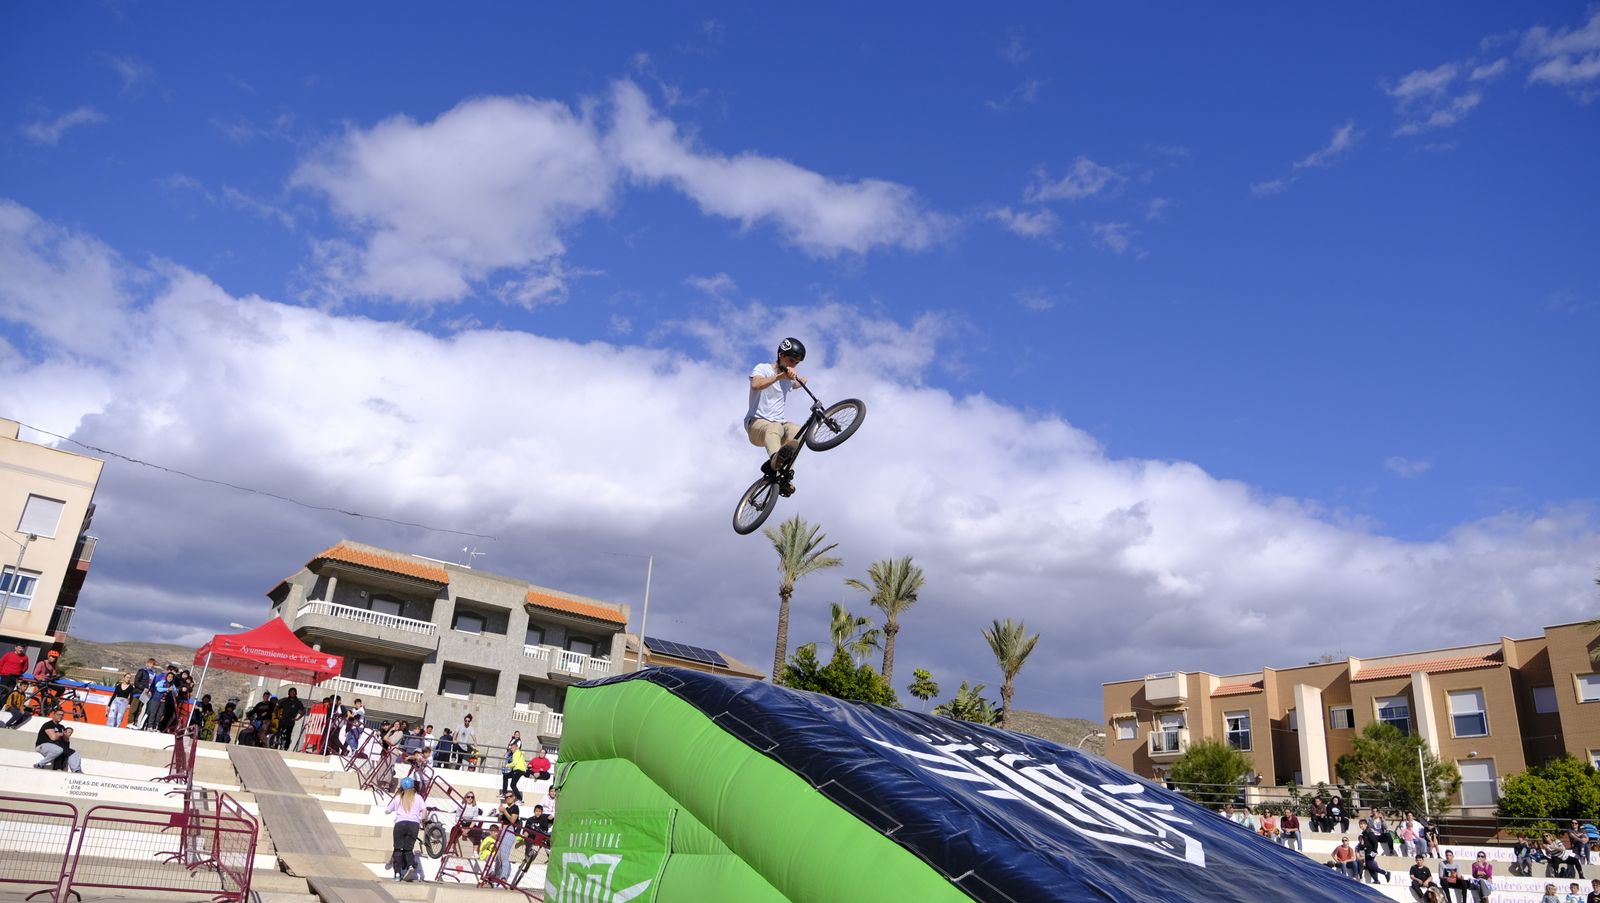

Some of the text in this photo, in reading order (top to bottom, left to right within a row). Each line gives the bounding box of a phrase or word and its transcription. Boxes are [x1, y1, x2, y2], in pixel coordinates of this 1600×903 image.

[240, 645, 288, 659] Ayuntamiento
[289, 653, 298, 661] de
[100, 782, 129, 790] ATENCIÓN
[129, 785, 159, 793] INMEDIATA
